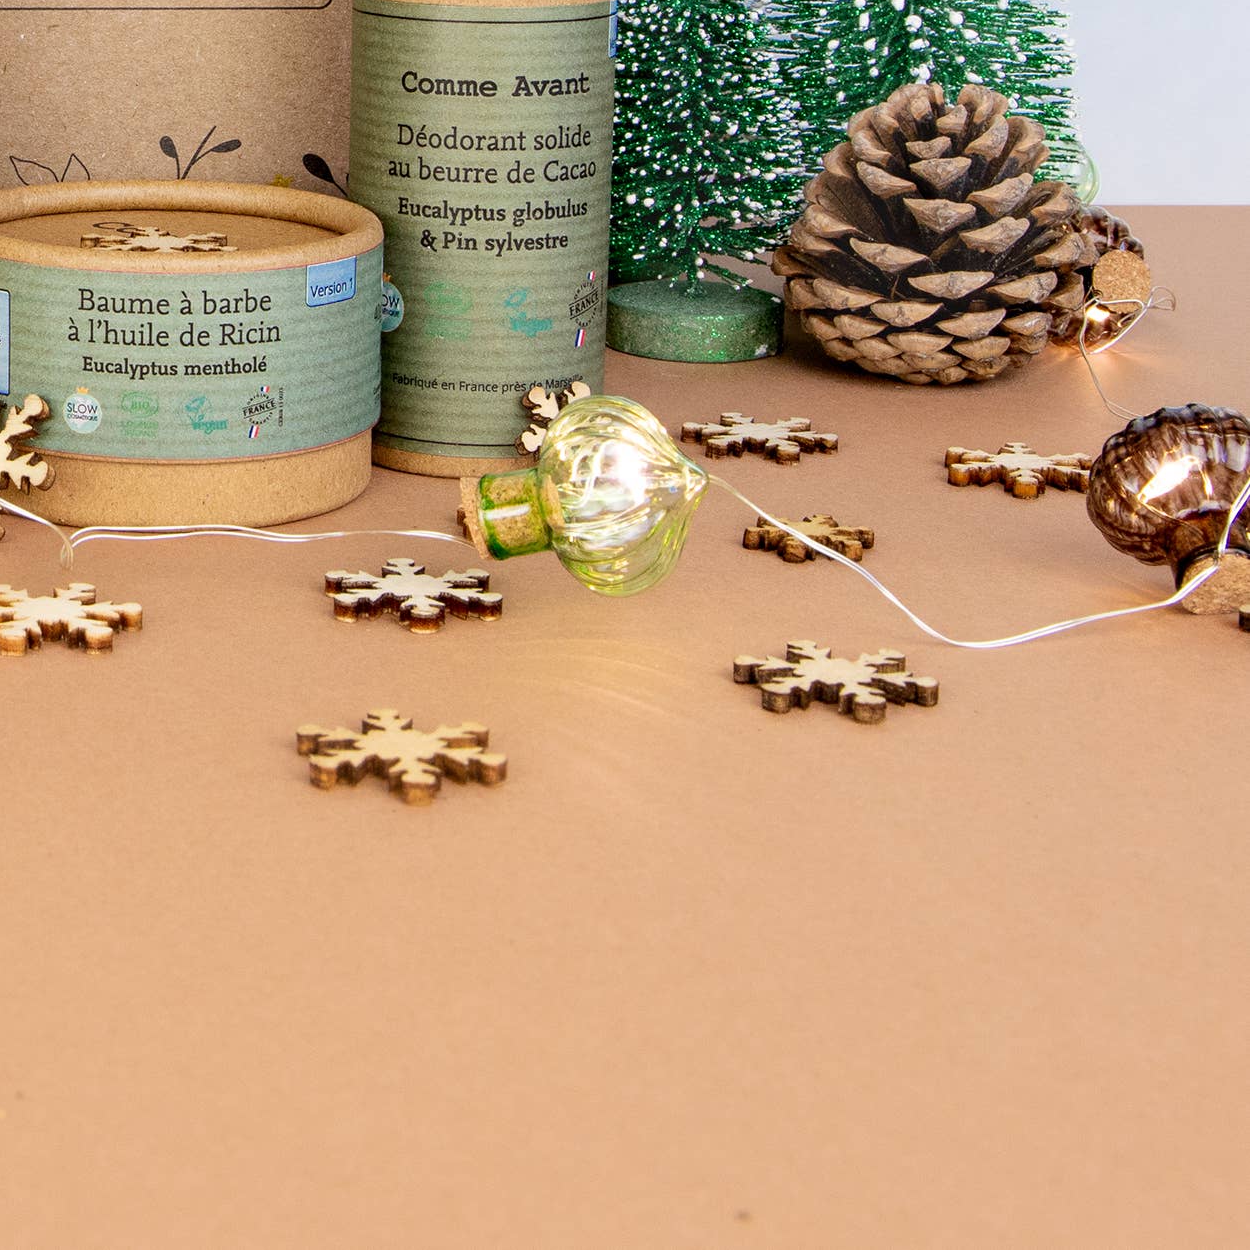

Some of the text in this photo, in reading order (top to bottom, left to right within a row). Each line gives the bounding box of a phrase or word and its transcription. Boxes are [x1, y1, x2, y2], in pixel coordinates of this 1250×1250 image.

[401, 70, 591, 98] Comme Avant
[396, 123, 592, 152] Déodorant solide
[388, 156, 597, 184] au beurre de Cacao
[397, 196, 588, 227] Eucalyptus globulus
[420, 229, 569, 258] & Pin sylvestre
[77, 287, 272, 315] Baume à barbe
[310, 281, 347, 298] Version
[67, 316, 282, 347] à l’huile de Ricin
[82, 355, 267, 381] Eucalyptus mentholé
[391, 372, 439, 391] Fabriqué
[440, 380, 456, 391] en
[458, 381, 499, 393] France
[501, 381, 527, 394] près
[66, 401, 98, 415] SLOW
[242, 400, 276, 417] FRANCE
